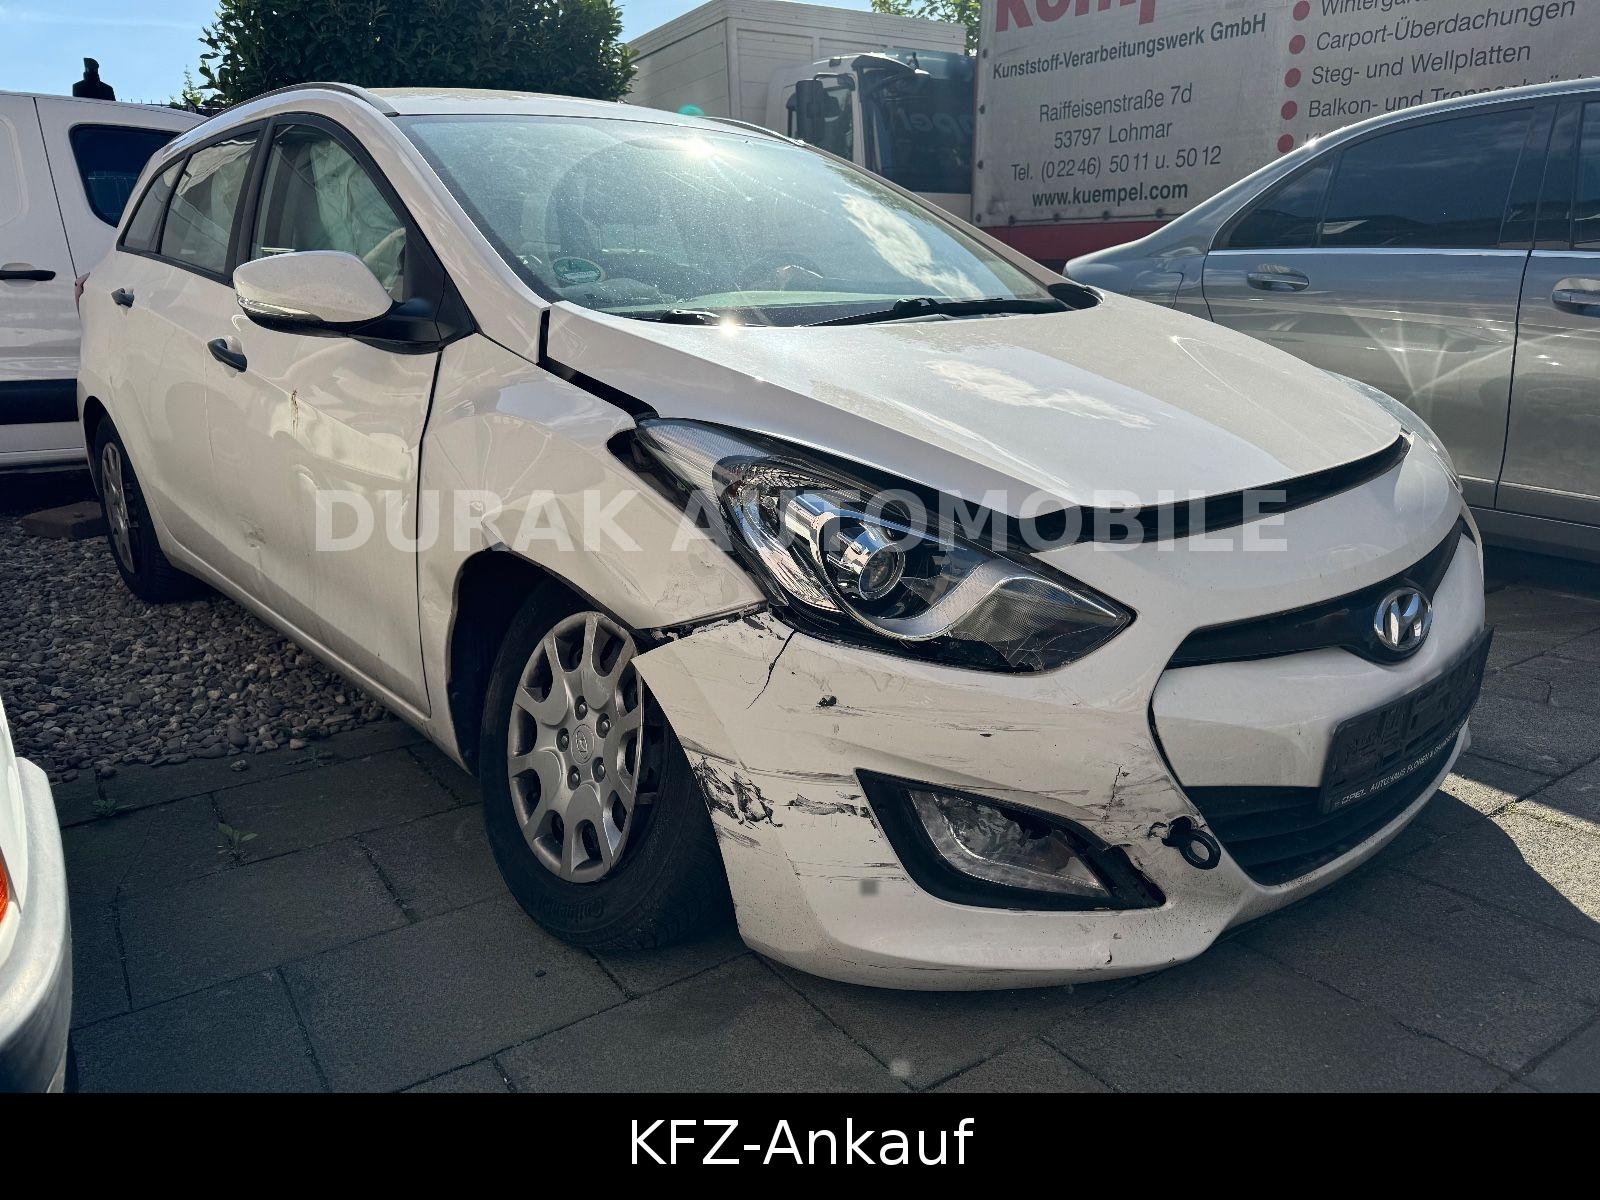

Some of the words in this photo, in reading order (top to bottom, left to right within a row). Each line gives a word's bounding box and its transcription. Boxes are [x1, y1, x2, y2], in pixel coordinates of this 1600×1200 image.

[1316, 0, 1575, 51] Carport-Überdachungen
[993, 26, 1204, 80] Kunststoff-Verarbeitungswerk
[1210, 13, 1267, 42] GmbH
[1311, 64, 1360, 85] Steg-
[1366, 60, 1404, 78] und
[1411, 45, 1531, 74] Wellplatten
[1039, 89, 1165, 122] Raiffeisenstraße
[1170, 83, 1193, 105] 7d
[1308, 98, 1378, 117] Balkon-
[1054, 127, 1101, 149] 53797
[1108, 121, 1173, 143] Lohmar
[1011, 163, 1033, 181] Tel.
[1155, 155, 1170, 170] u.
[1032, 182, 1188, 207] www.kuempel.com
